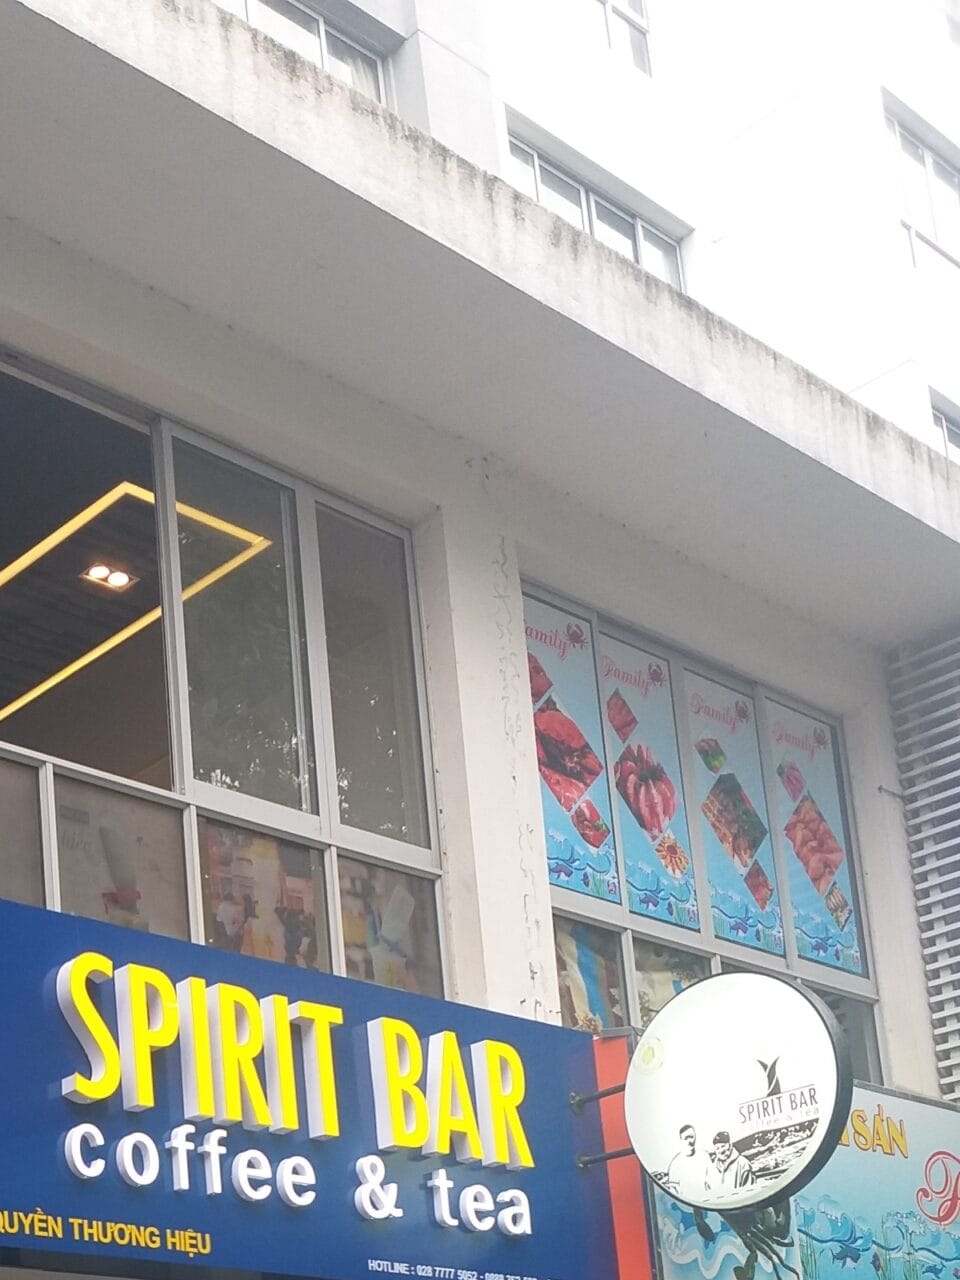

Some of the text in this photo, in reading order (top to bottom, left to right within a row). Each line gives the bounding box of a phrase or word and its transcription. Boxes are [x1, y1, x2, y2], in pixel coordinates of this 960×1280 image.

[525, 623, 569, 660] amily
[57, 951, 534, 1170] SPIRIT BAR
[738, 1087, 818, 1124] SPIRIT BAR
[64, 1122, 532, 1236] coffee & tea
[69, 1218, 161, 1248] THƯƠNG
[166, 1229, 211, 1258] HIỆU
[416, 1264, 433, 1277] 028
[434, 1266, 455, 1279] 7777
